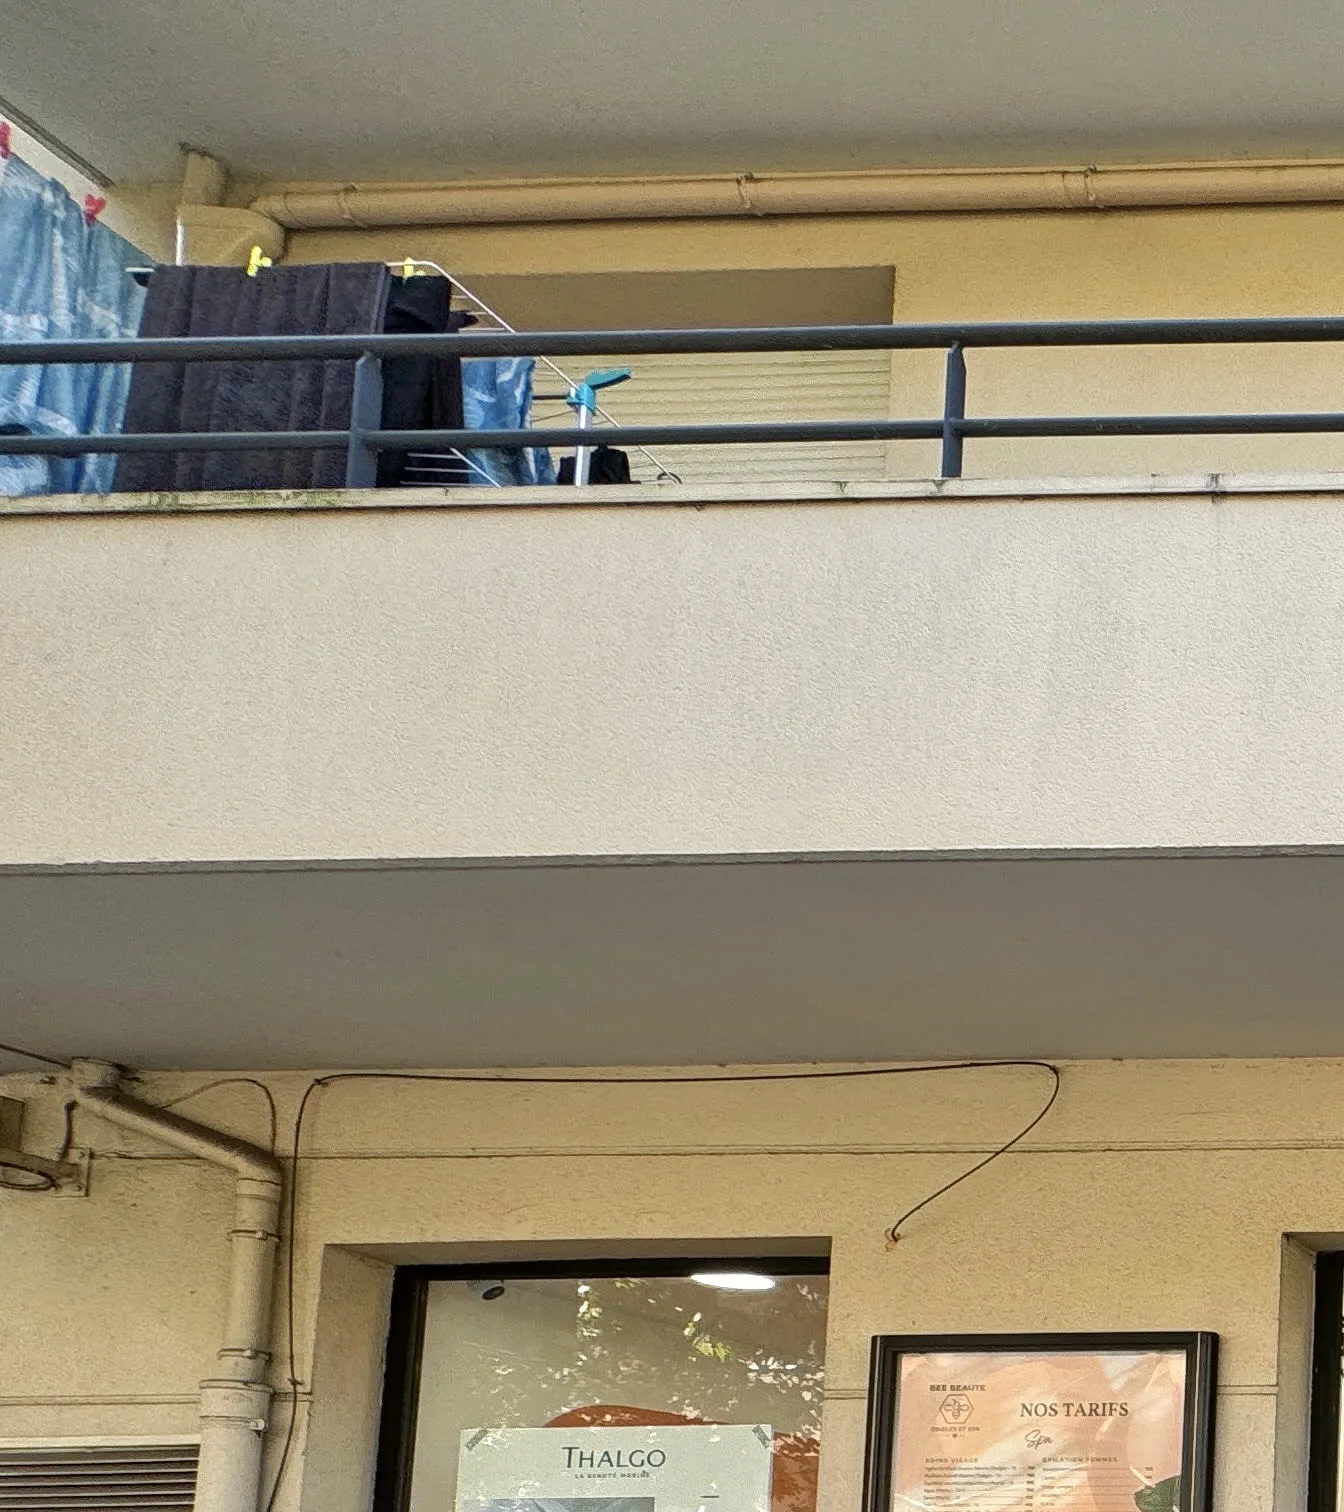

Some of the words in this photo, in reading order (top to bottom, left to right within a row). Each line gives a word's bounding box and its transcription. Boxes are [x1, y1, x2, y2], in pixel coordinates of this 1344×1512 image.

[929, 1384, 948, 1392] BEE
[1019, 1402, 1059, 1418] NOS
[1062, 1401, 1130, 1418] TARIFS
[1024, 1428, 1053, 1450] Spa
[562, 1446, 667, 1469] THALGO
